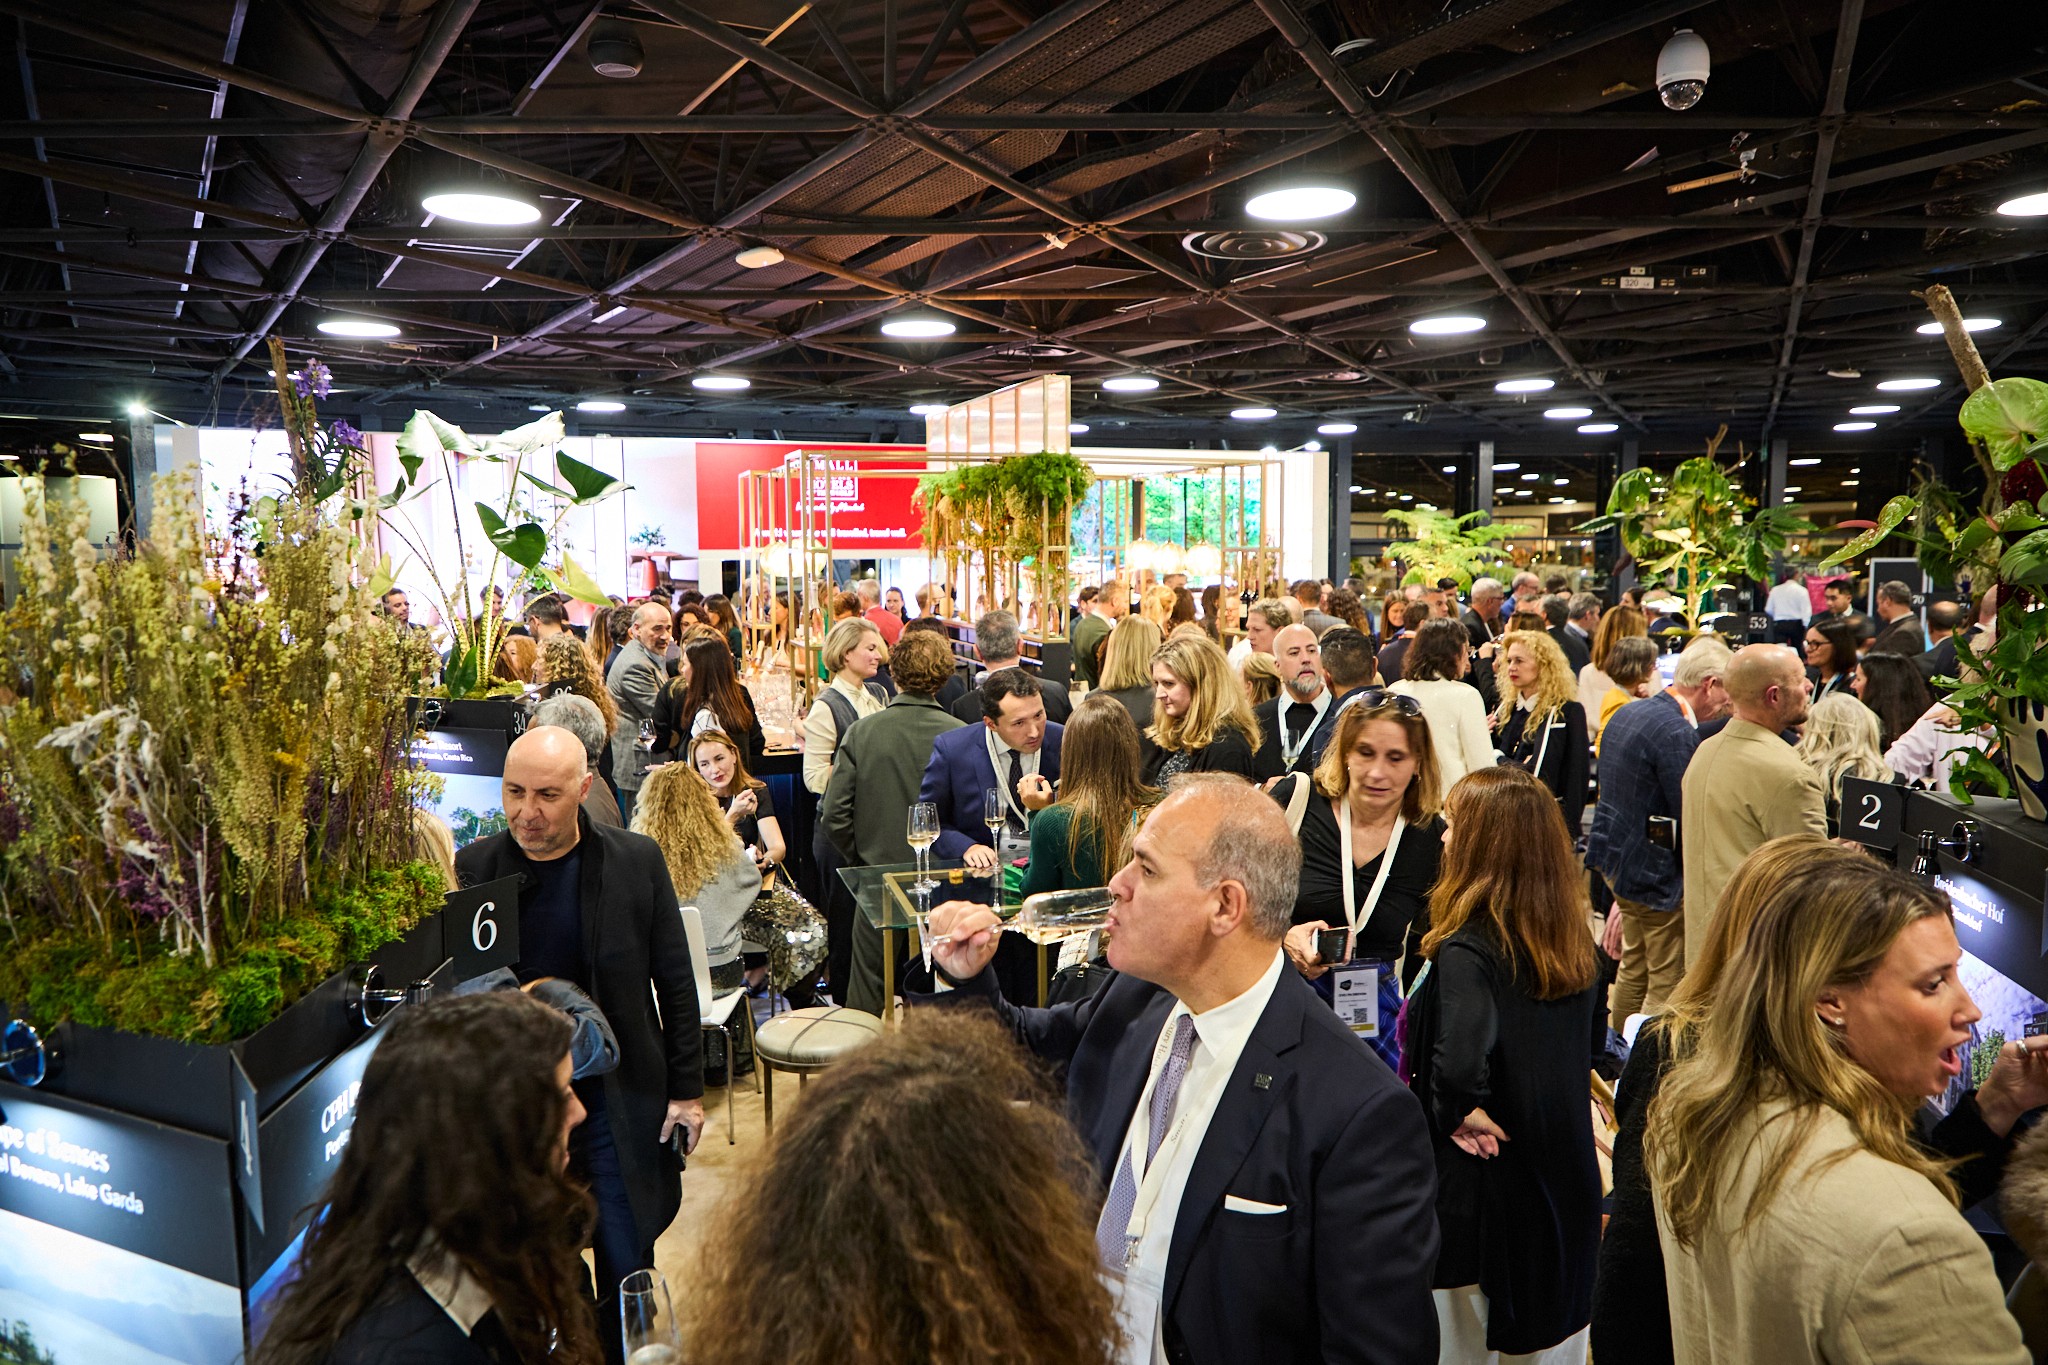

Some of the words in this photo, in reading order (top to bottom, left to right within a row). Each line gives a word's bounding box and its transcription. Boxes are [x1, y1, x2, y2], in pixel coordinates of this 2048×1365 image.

[1749, 616, 1768, 630] 53
[513, 711, 528, 735] 34
[461, 754, 474, 762] Rica
[1858, 794, 1883, 831] 2
[472, 900, 498, 952] 6
[1987, 901, 2005, 925] Hof
[321, 1089, 349, 1134] CPH
[240, 1100, 253, 1177] 4
[64, 1172, 99, 1201] Lake
[99, 1183, 145, 1215] Garda
